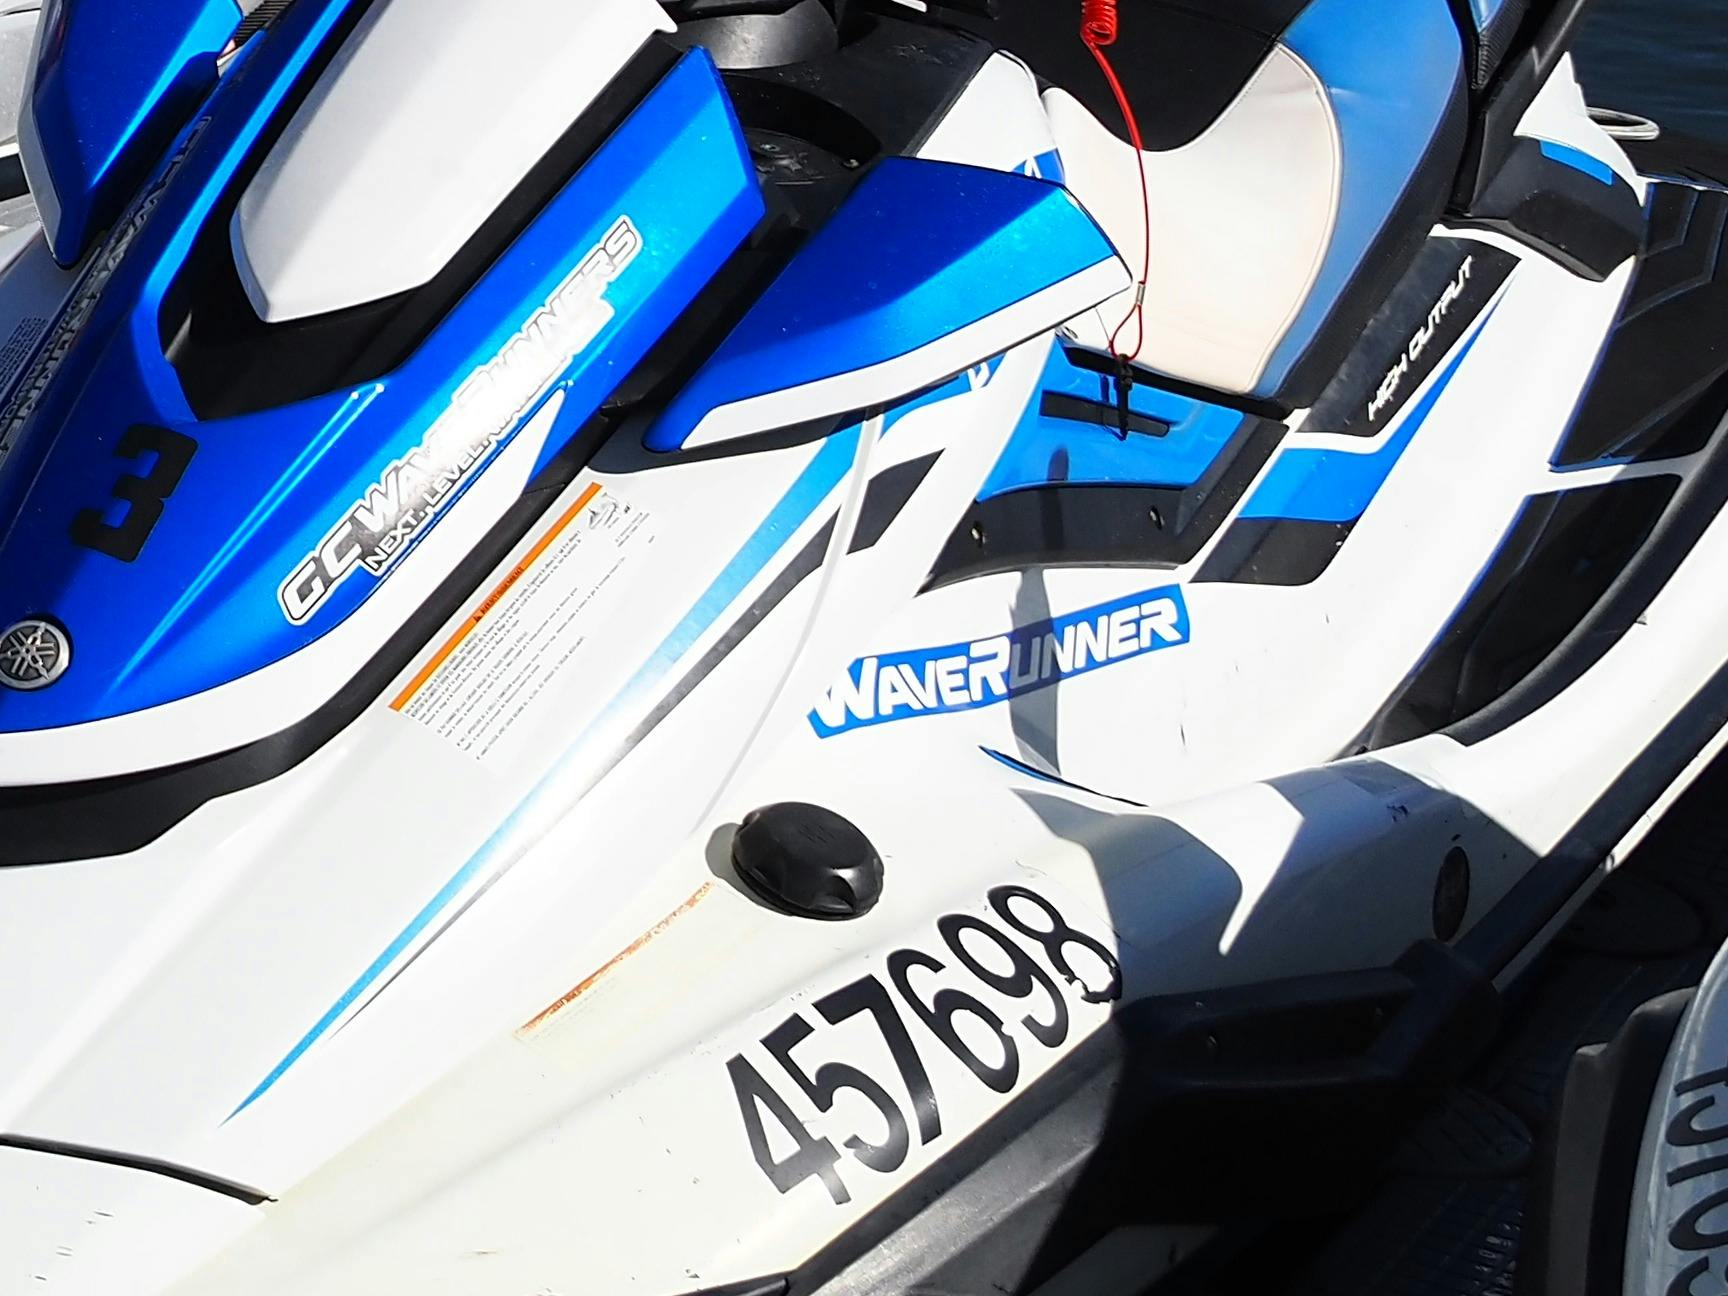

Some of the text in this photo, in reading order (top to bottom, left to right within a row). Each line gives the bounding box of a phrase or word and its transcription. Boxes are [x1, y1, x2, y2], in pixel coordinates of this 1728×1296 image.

[1408, 254, 1474, 362] OUTPUT
[281, 519, 364, 622] GC
[355, 216, 640, 535] WAVRUNNERS
[69, 423, 199, 563] 3
[811, 596, 1185, 729] WAVERUNNER
[725, 884, 1123, 1206] 457698
